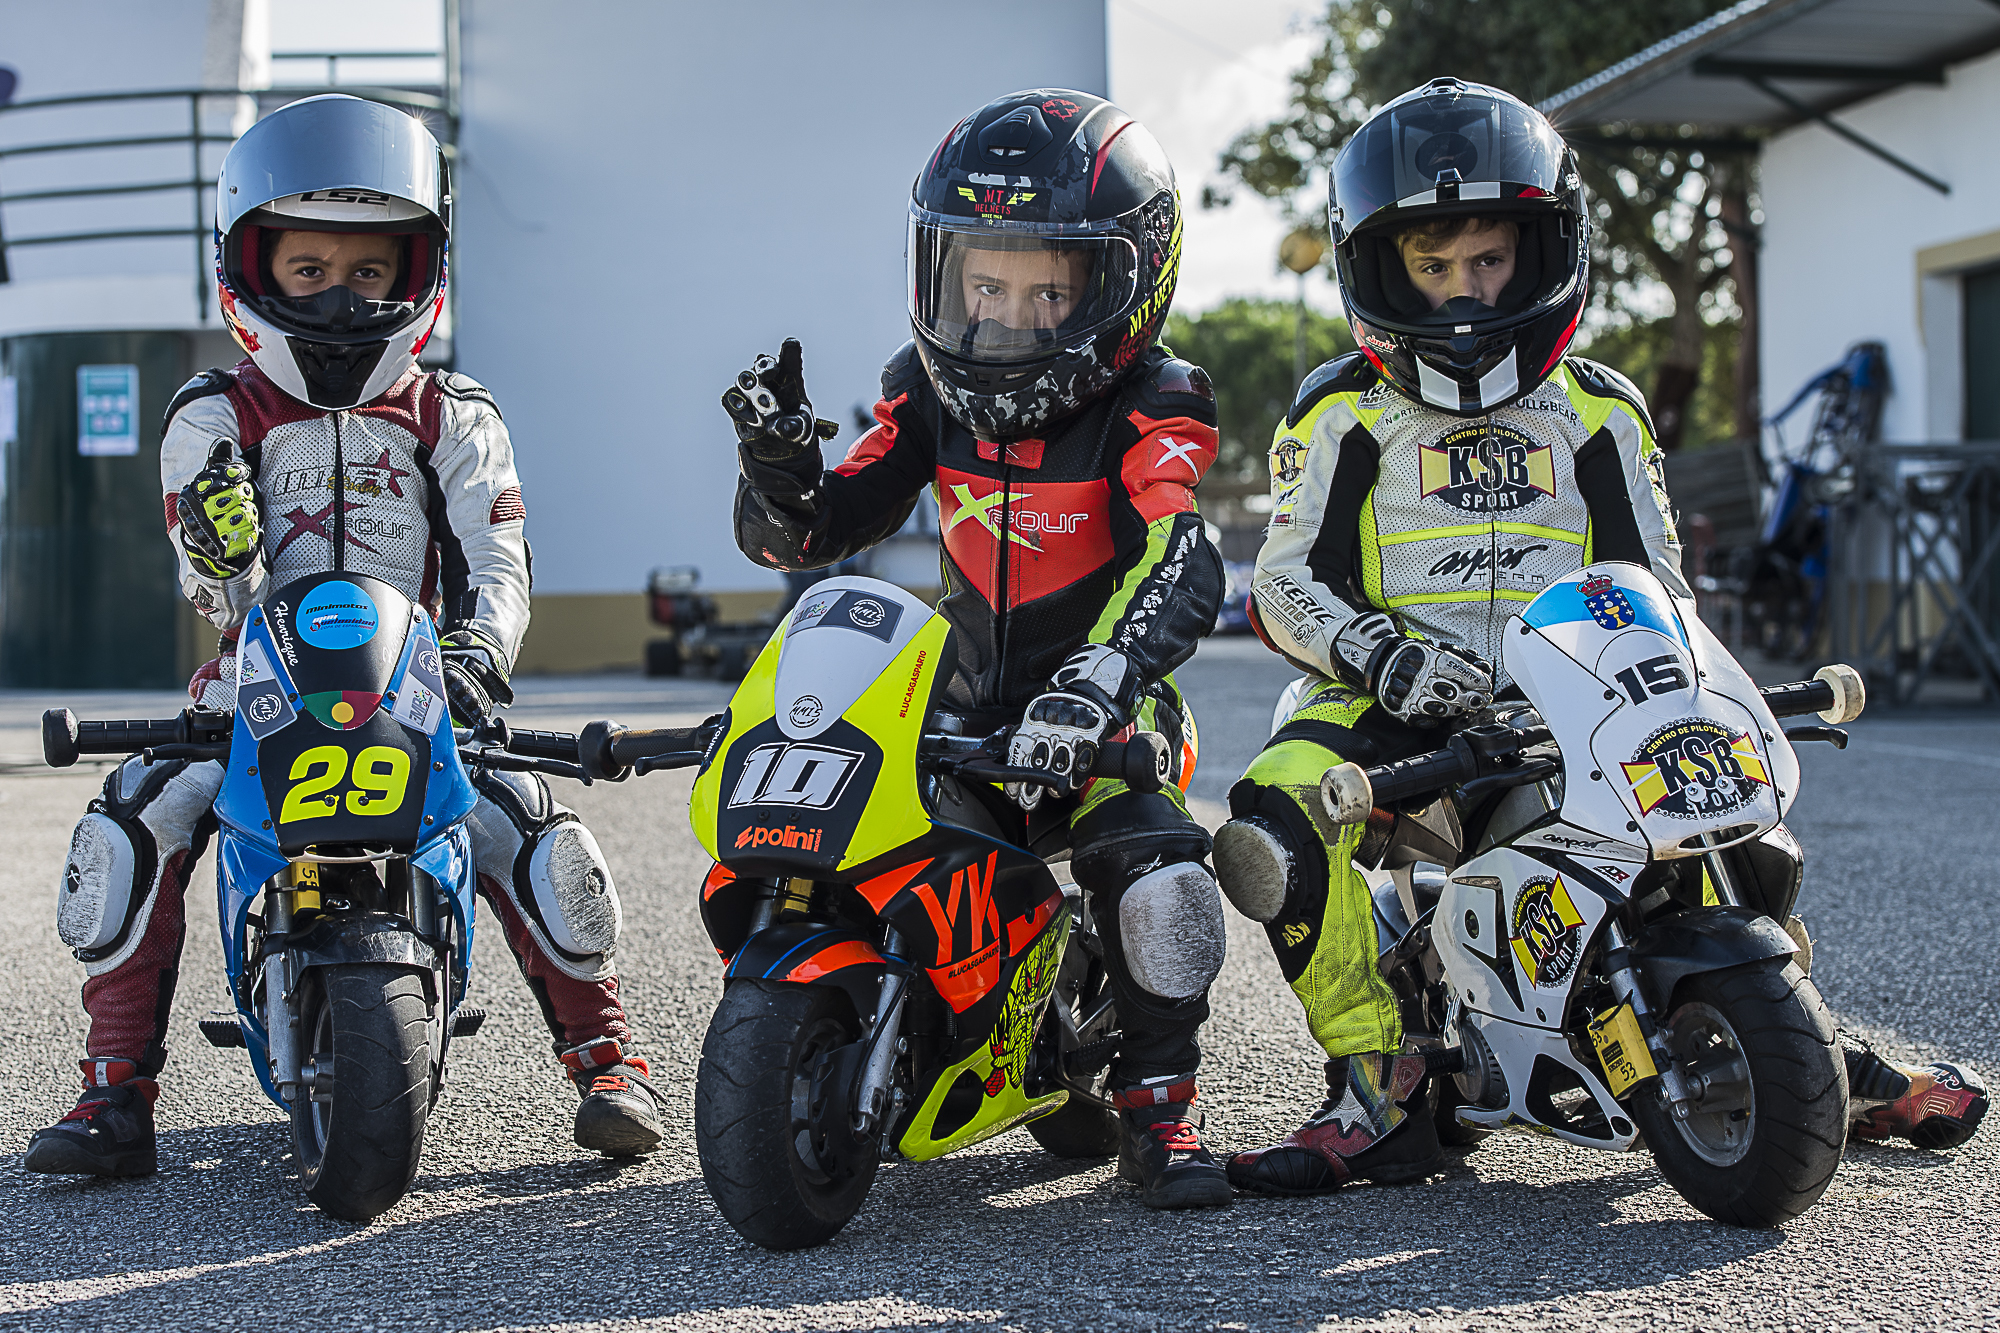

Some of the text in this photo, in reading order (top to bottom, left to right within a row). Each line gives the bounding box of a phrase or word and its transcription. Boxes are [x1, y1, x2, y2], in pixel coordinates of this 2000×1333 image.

[300, 190, 390, 207] LS2
[975, 203, 1011, 215] HELMETS
[984, 189, 1004, 204] MT
[1130, 298, 1151, 338] MT
[1445, 428, 1478, 445] CENTRO
[1493, 427, 1529, 446] PILOTAJE
[1447, 437, 1530, 492] KSB
[1461, 490, 1519, 509] SPORT
[312, 613, 339, 624] mini
[1260, 582, 1307, 622] RACING
[273, 600, 299, 667] Henrique
[899, 650, 927, 719] #LUCASGASPAR10
[1446, 660, 1481, 684] RAINERS
[1613, 653, 1690, 707] 15
[1646, 724, 1729, 754] CENTRO DE PILOTAJE
[279, 745, 411, 825] 29
[727, 742, 866, 811] 10
[1652, 736, 1746, 797] KSB
[751, 825, 816, 852] polini
[1515, 902, 1525, 928] CENTRO
[1527, 884, 1547, 898] PILOTAJE
[1519, 892, 1567, 969] KSB
[1545, 941, 1574, 979] SPORT
[1620, 1061, 1637, 1082] 53
